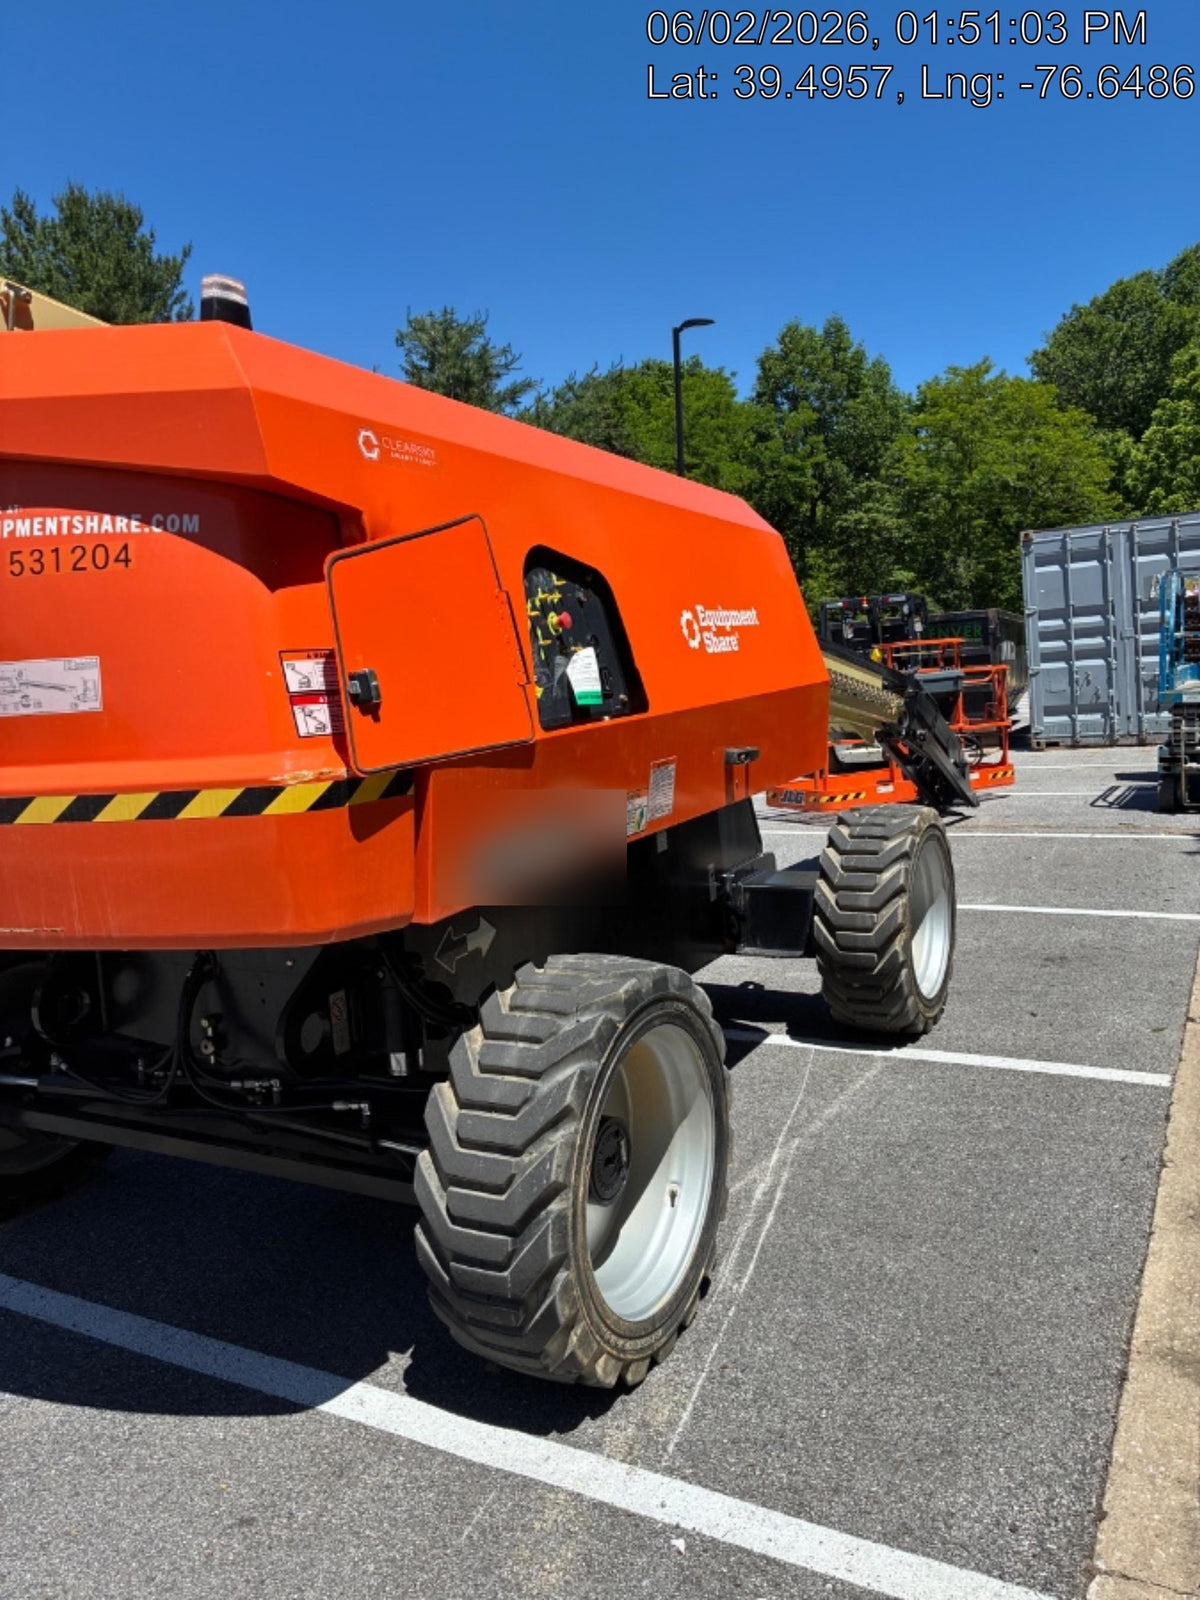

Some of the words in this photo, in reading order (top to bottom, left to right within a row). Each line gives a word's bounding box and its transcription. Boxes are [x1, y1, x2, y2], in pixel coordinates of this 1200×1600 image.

[0, 513, 200, 538] PMENTSHARE.COM
[9, 543, 132, 577] 531204
[695, 604, 760, 631] Equipment
[702, 631, 739, 654] Share
[780, 790, 805, 805] JLG
